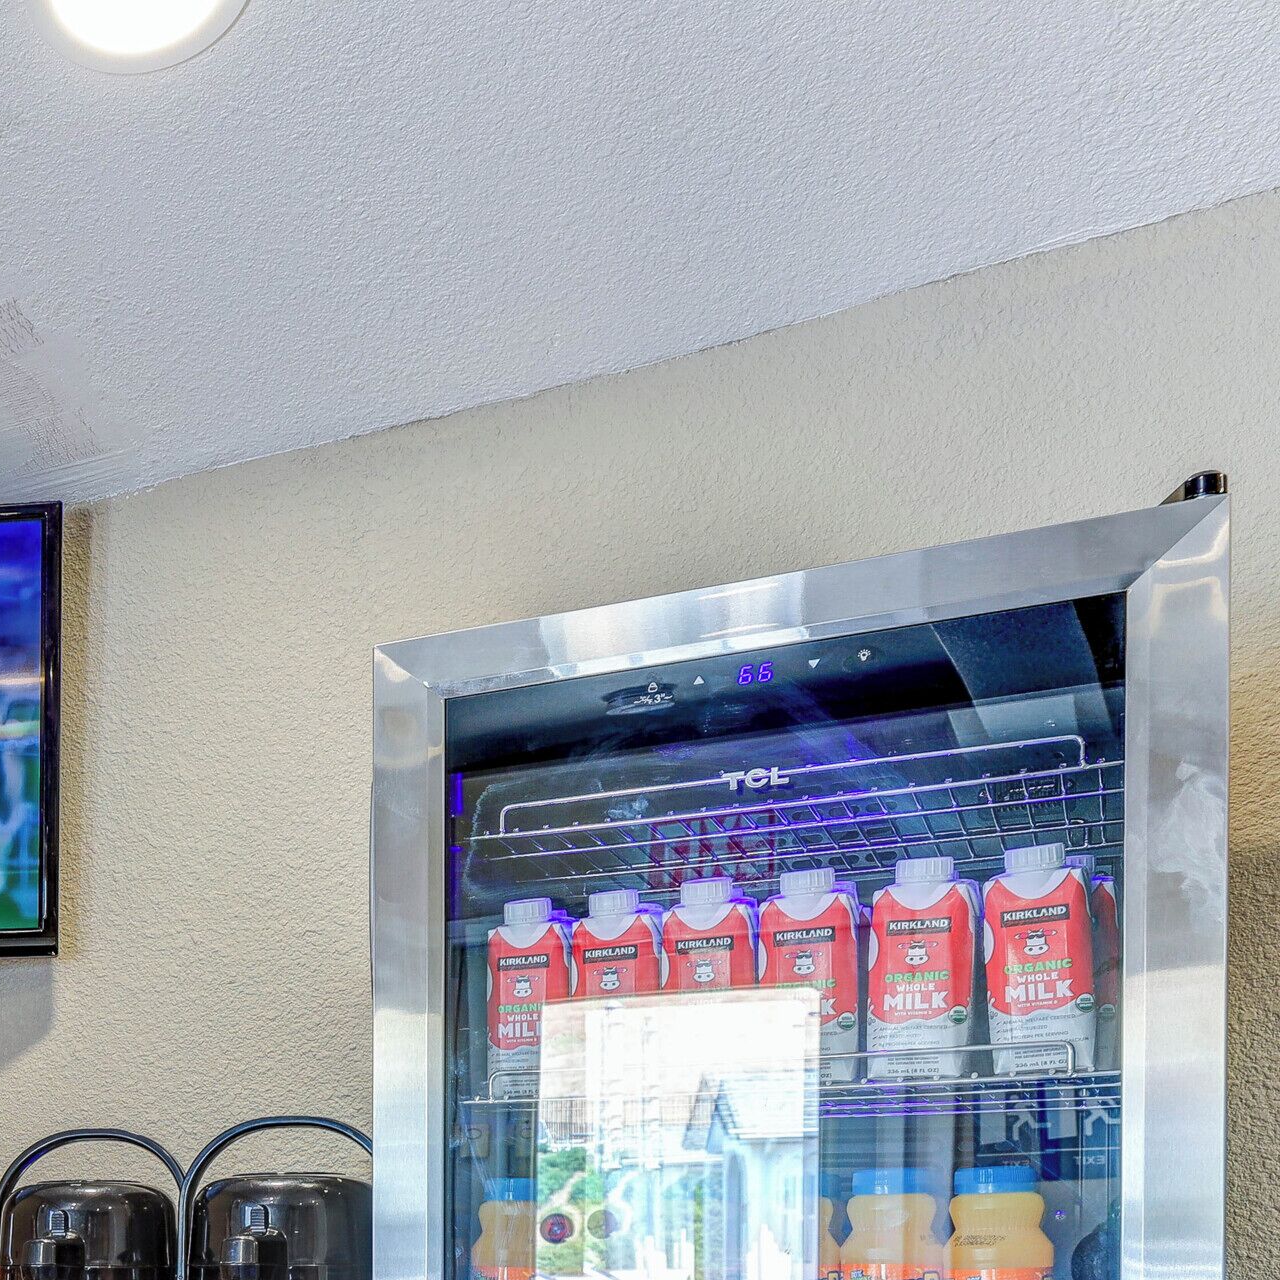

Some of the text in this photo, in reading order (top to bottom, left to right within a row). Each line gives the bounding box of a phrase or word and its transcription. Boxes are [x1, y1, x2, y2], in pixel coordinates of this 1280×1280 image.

[722, 766, 790, 791] TCL
[1003, 906, 1067, 921] KIRKLAND
[889, 919, 949, 931] KIRKLAND
[776, 929, 833, 941] KIRKLAND
[678, 937, 732, 950] KIRKLAND
[585, 946, 636, 958] KIRKLAND
[500, 955, 547, 966] KIRKLAND
[1004, 958, 1073, 975] ORGANIC
[885, 971, 950, 983] ORGANIC
[1017, 972, 1059, 982] WHOLE
[896, 983, 935, 992] WHOLE
[1005, 979, 1075, 1003] MILK
[884, 991, 949, 1011] MILK
